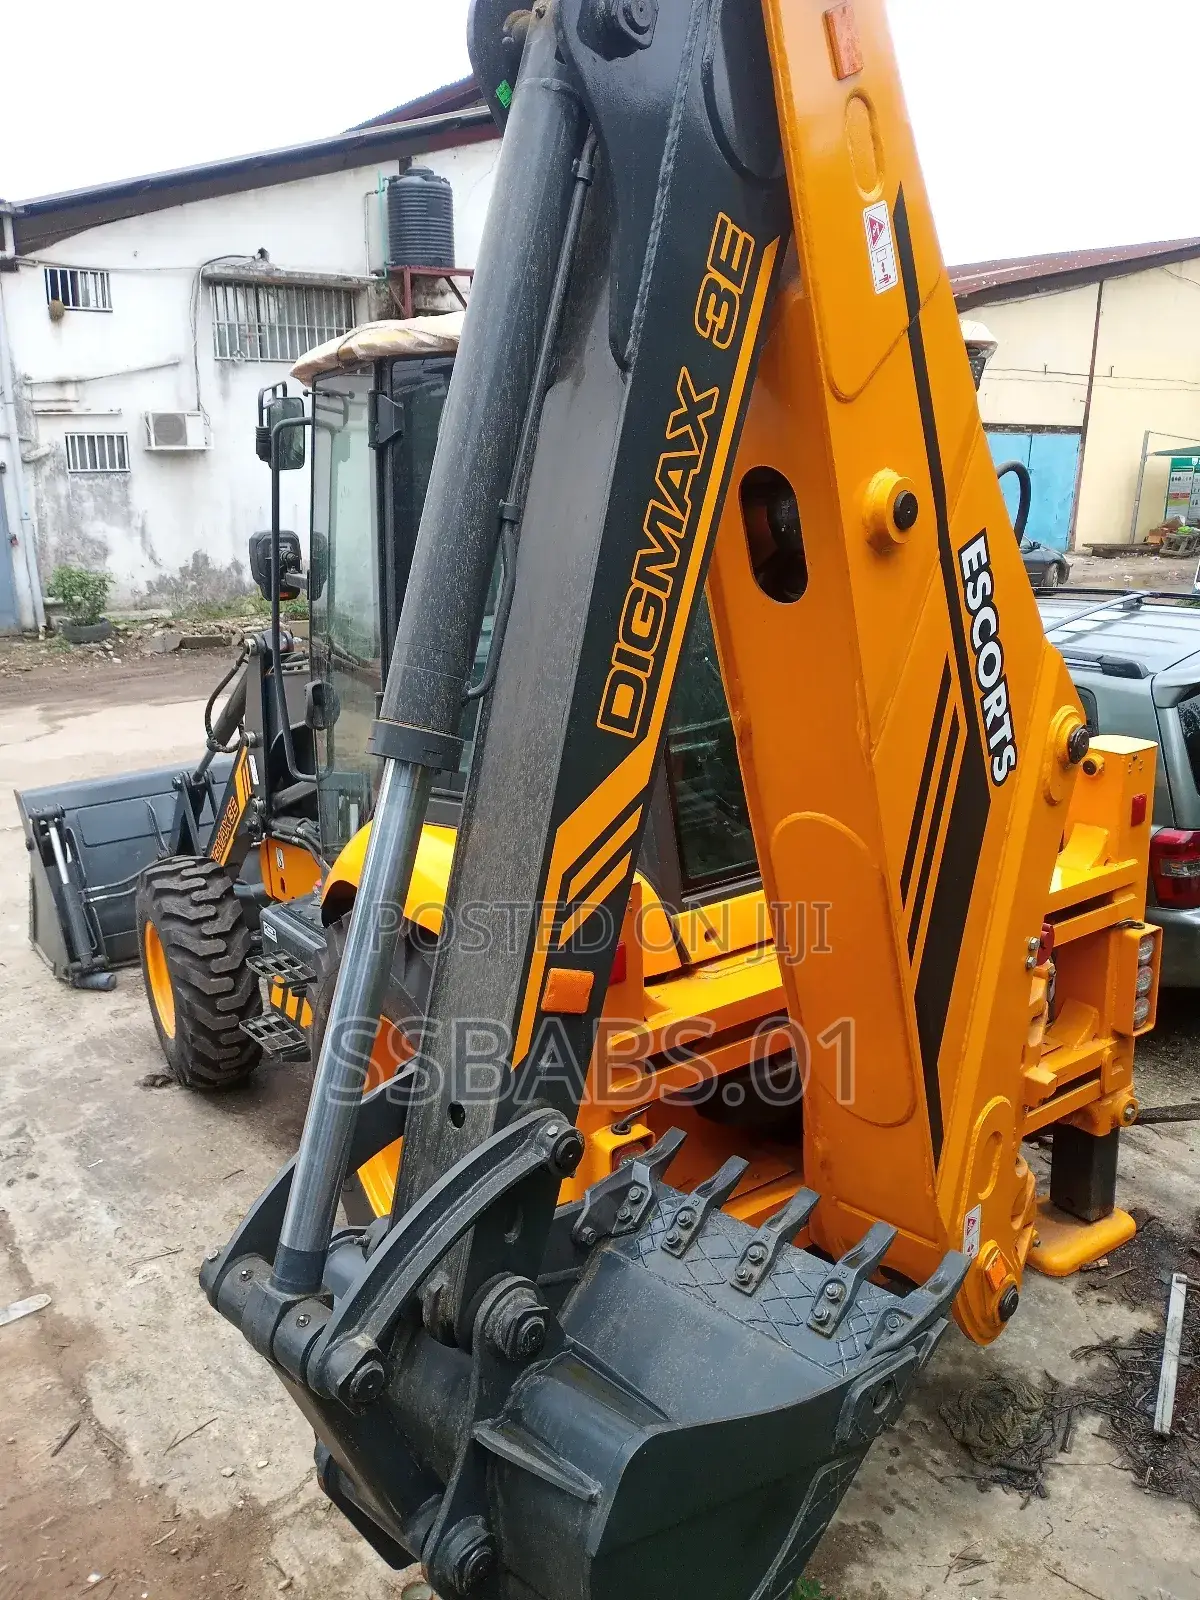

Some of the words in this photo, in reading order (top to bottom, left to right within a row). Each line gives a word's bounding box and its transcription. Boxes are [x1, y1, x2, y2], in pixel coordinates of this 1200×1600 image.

[596, 366, 719, 738] DIGMAX
[694, 212, 755, 349] 3E
[959, 533, 1016, 784] ESCORTS
